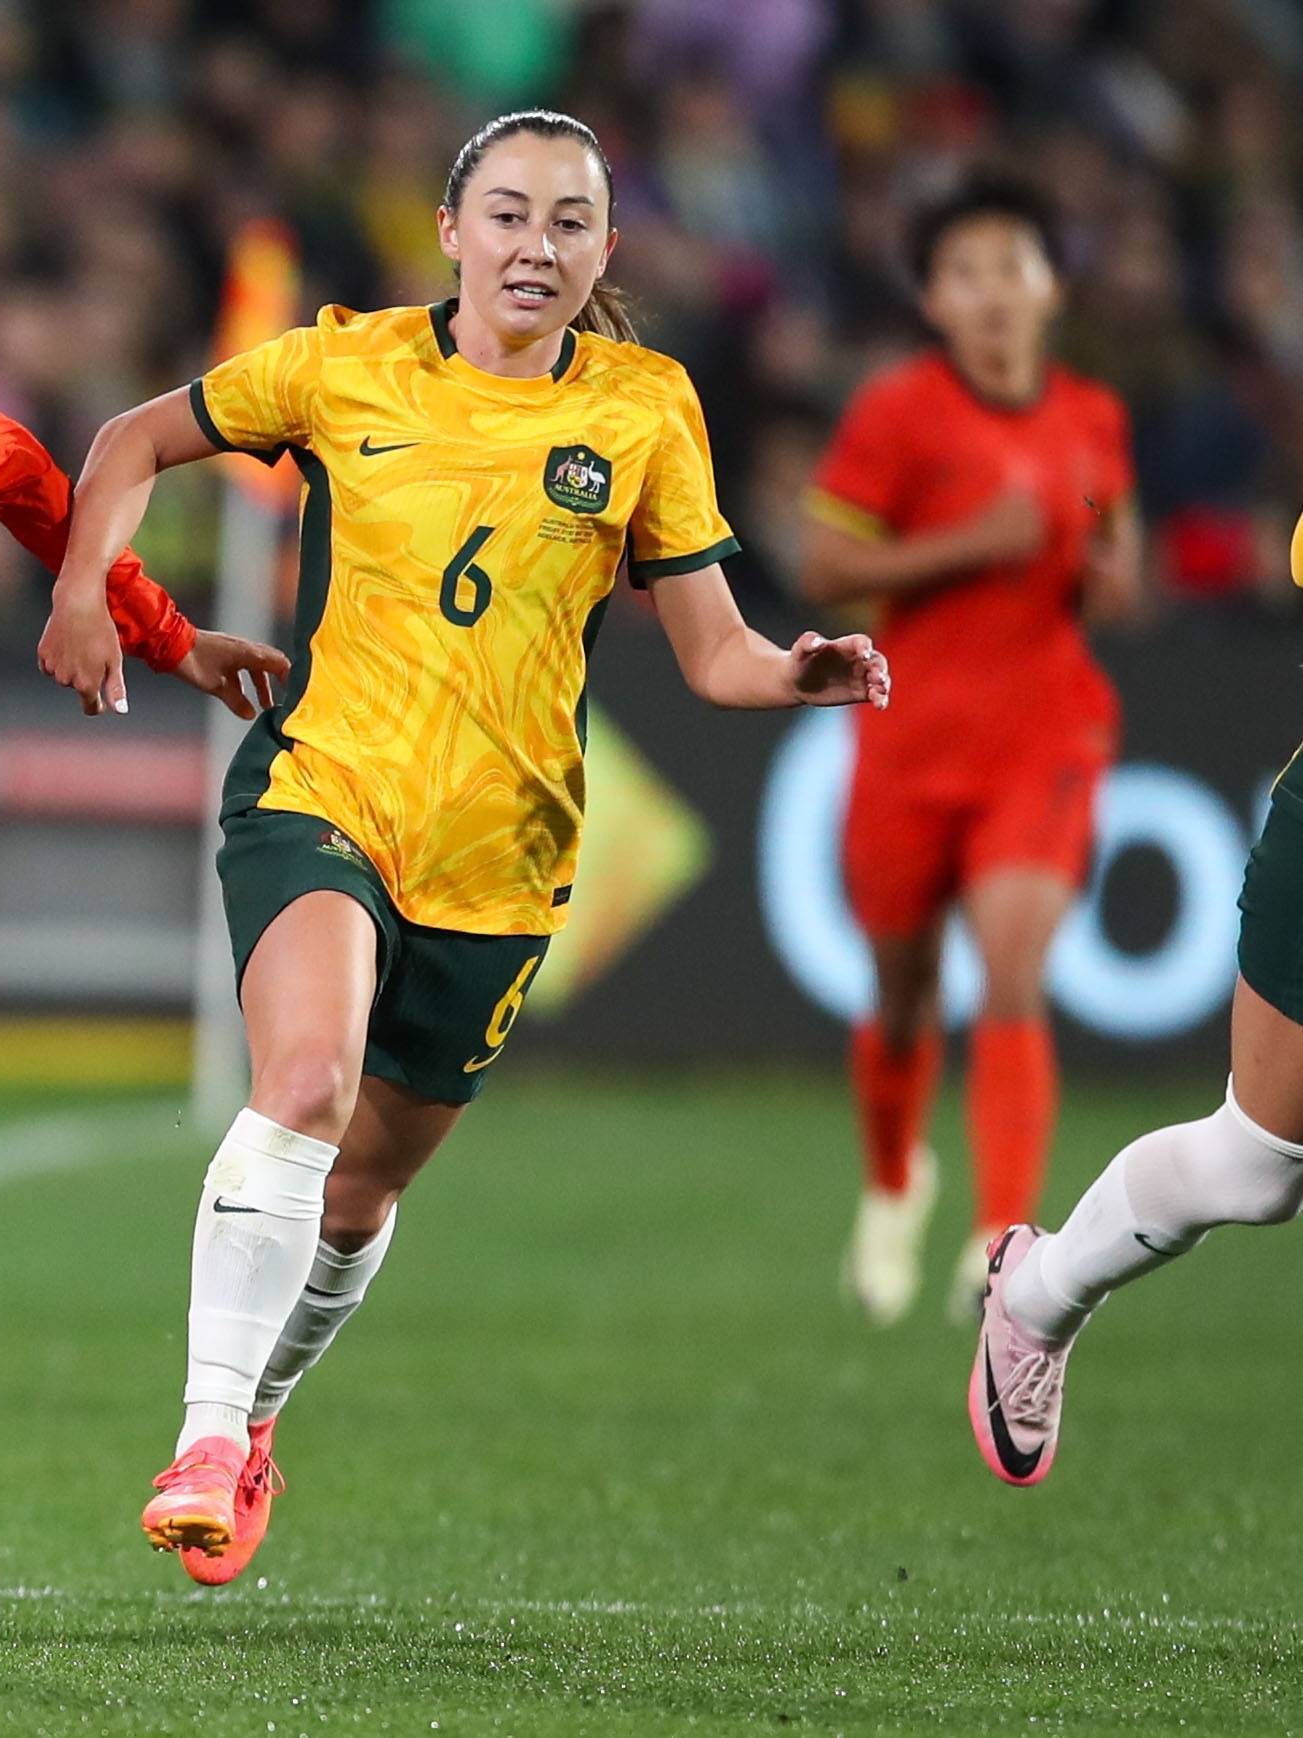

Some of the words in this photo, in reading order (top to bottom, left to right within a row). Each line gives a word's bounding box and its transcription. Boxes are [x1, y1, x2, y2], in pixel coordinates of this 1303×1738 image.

[554, 483, 598, 501] AUSTRALIA
[439, 525, 496, 628] 6
[485, 955, 540, 1048] 6
